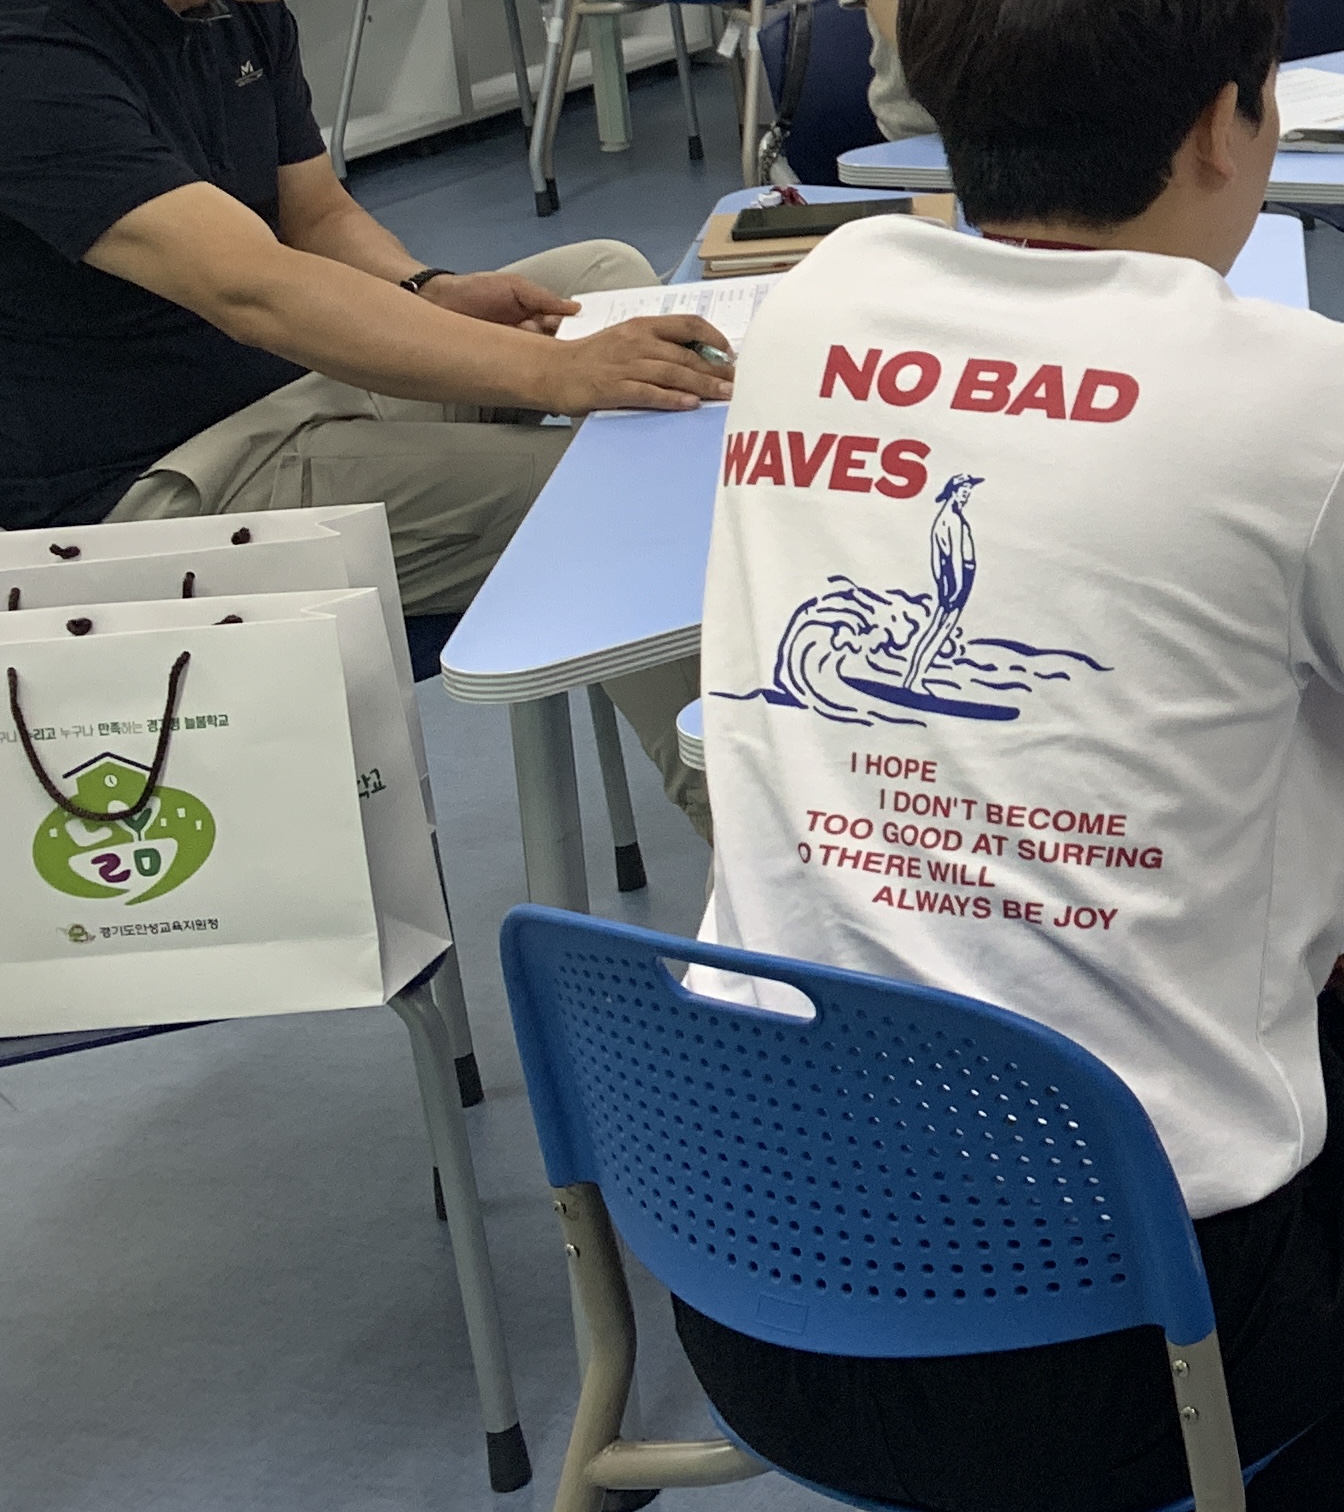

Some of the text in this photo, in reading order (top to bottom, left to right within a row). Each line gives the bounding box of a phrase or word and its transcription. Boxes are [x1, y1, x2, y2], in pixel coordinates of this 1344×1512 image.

[819, 345, 1140, 424] NO BAD
[724, 430, 932, 500] WAVES
[60, 724, 94, 738] 누구나
[184, 714, 229, 731] 늘봄학교
[851, 753, 938, 784] I HOPE
[879, 790, 1127, 837] I DON'T BECOME
[806, 810, 1163, 871] TOO GOOD AT SURFING
[818, 844, 922, 880] THERE
[926, 861, 996, 888] WILL
[872, 885, 1118, 931] ALWAYS BE JOY
